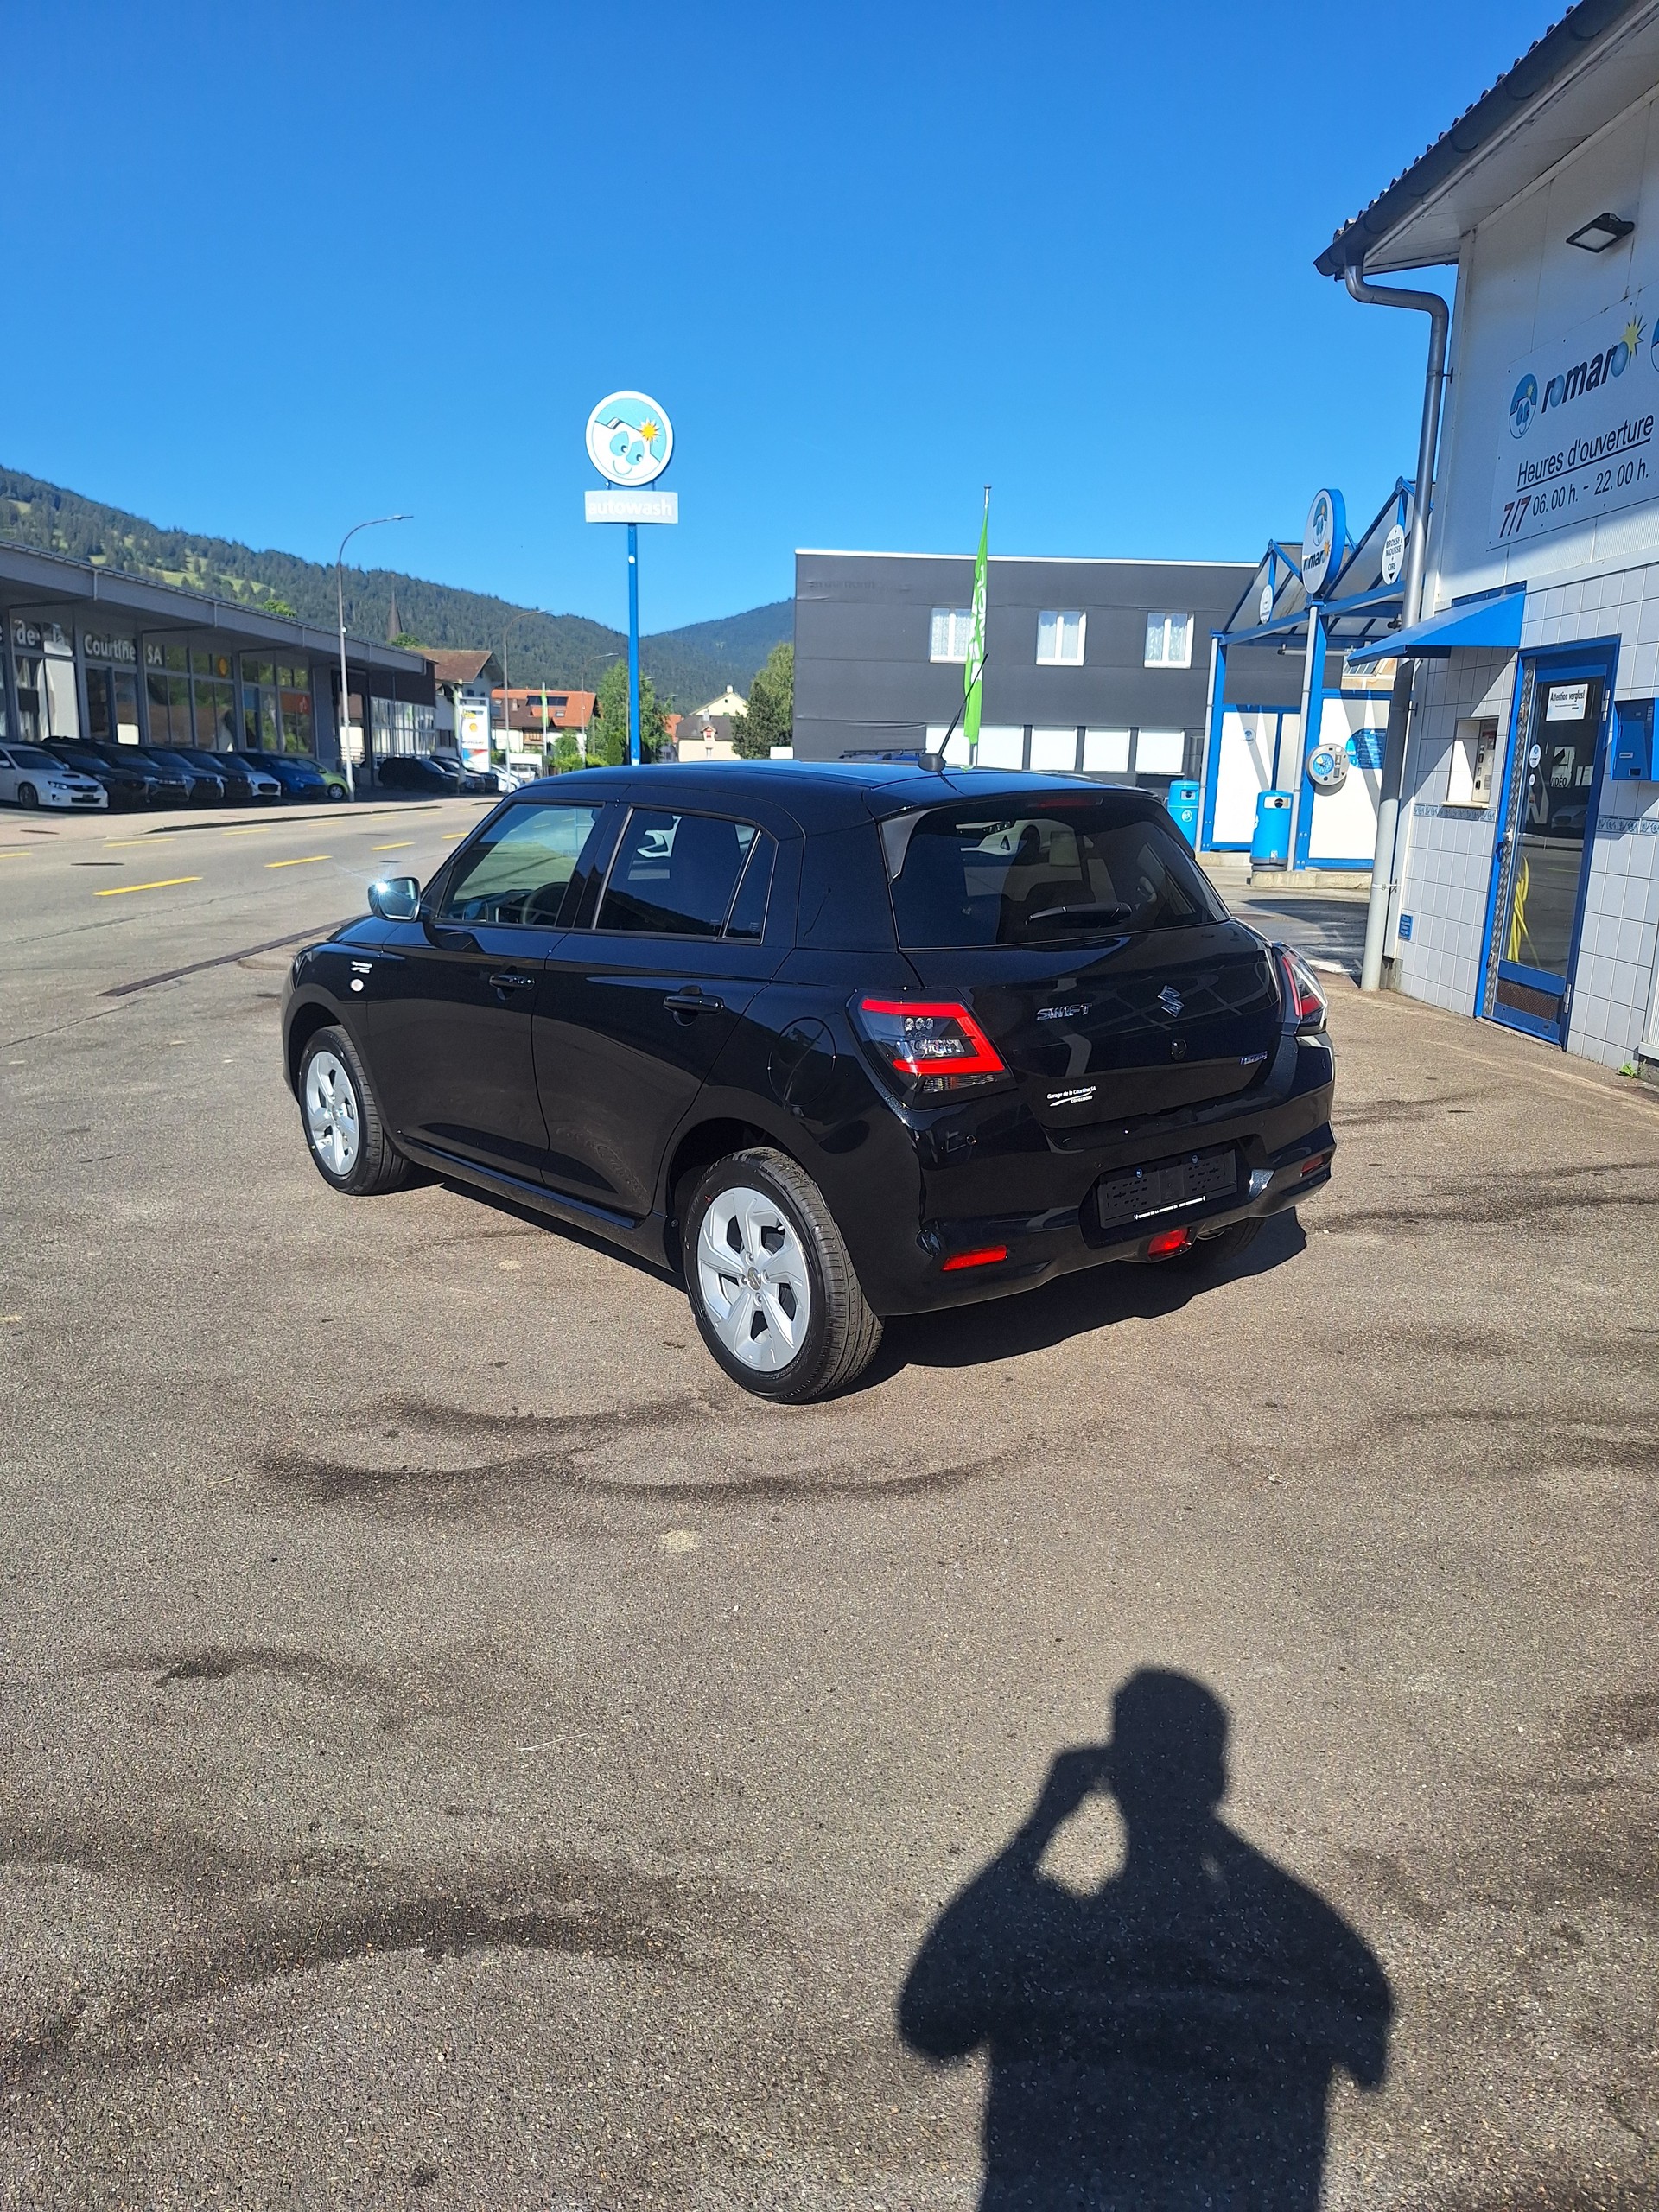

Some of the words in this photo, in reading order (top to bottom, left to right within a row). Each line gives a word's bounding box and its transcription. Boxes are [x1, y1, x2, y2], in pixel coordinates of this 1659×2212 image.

[1541, 340, 1629, 414] romaro
[1516, 451, 1564, 487] Heures
[1567, 414, 1654, 468] d'ouverture
[1499, 494, 1532, 538] 7/7
[1567, 484, 1578, 505] h.
[1637, 458, 1649, 481] h.
[588, 498, 672, 517] autowash
[1385, 536, 1401, 549] BROSSE
[1385, 545, 1402, 557] MOUSSE
[1387, 562, 1396, 572] CIRE
[15, 620, 36, 646] de
[84, 633, 137, 662] Courtine
[147, 645, 162, 666] SA
[1550, 691, 1568, 702] Attention
[1037, 1003, 1092, 1020] SWIFT
[1047, 1090, 1063, 1100] Garage
